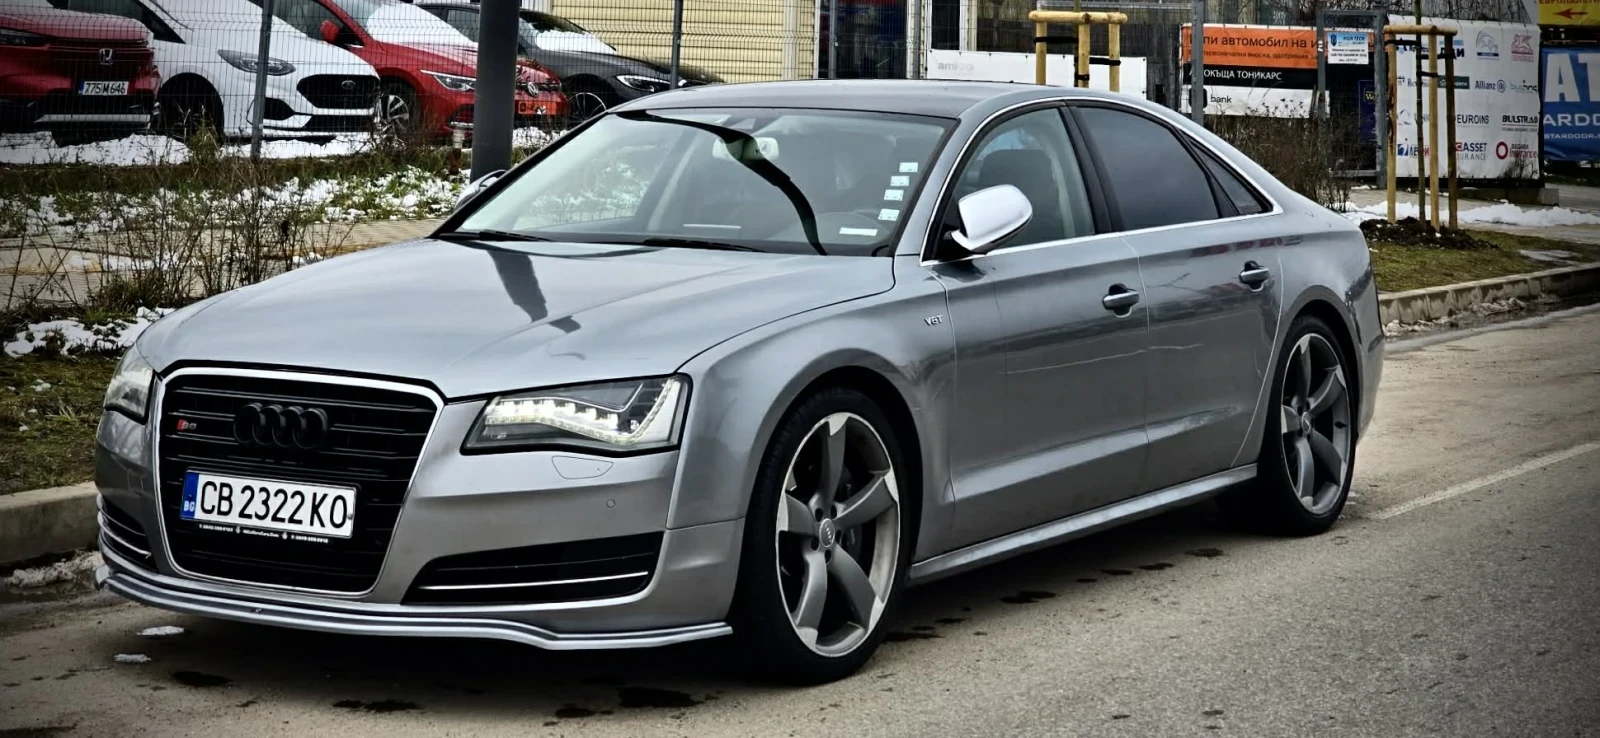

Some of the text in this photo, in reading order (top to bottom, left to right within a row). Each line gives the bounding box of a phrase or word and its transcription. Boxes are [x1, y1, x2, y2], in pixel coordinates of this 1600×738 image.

[1221, 36, 1288, 48] автомобил
[1291, 38, 1307, 48] на
[1237, 70, 1282, 80] ТОНИКАРС
[1475, 80, 1496, 90] Allianz
[1211, 95, 1232, 103] bank
[183, 501, 195, 512] BG
[200, 480, 348, 529] CB 2322 KO
